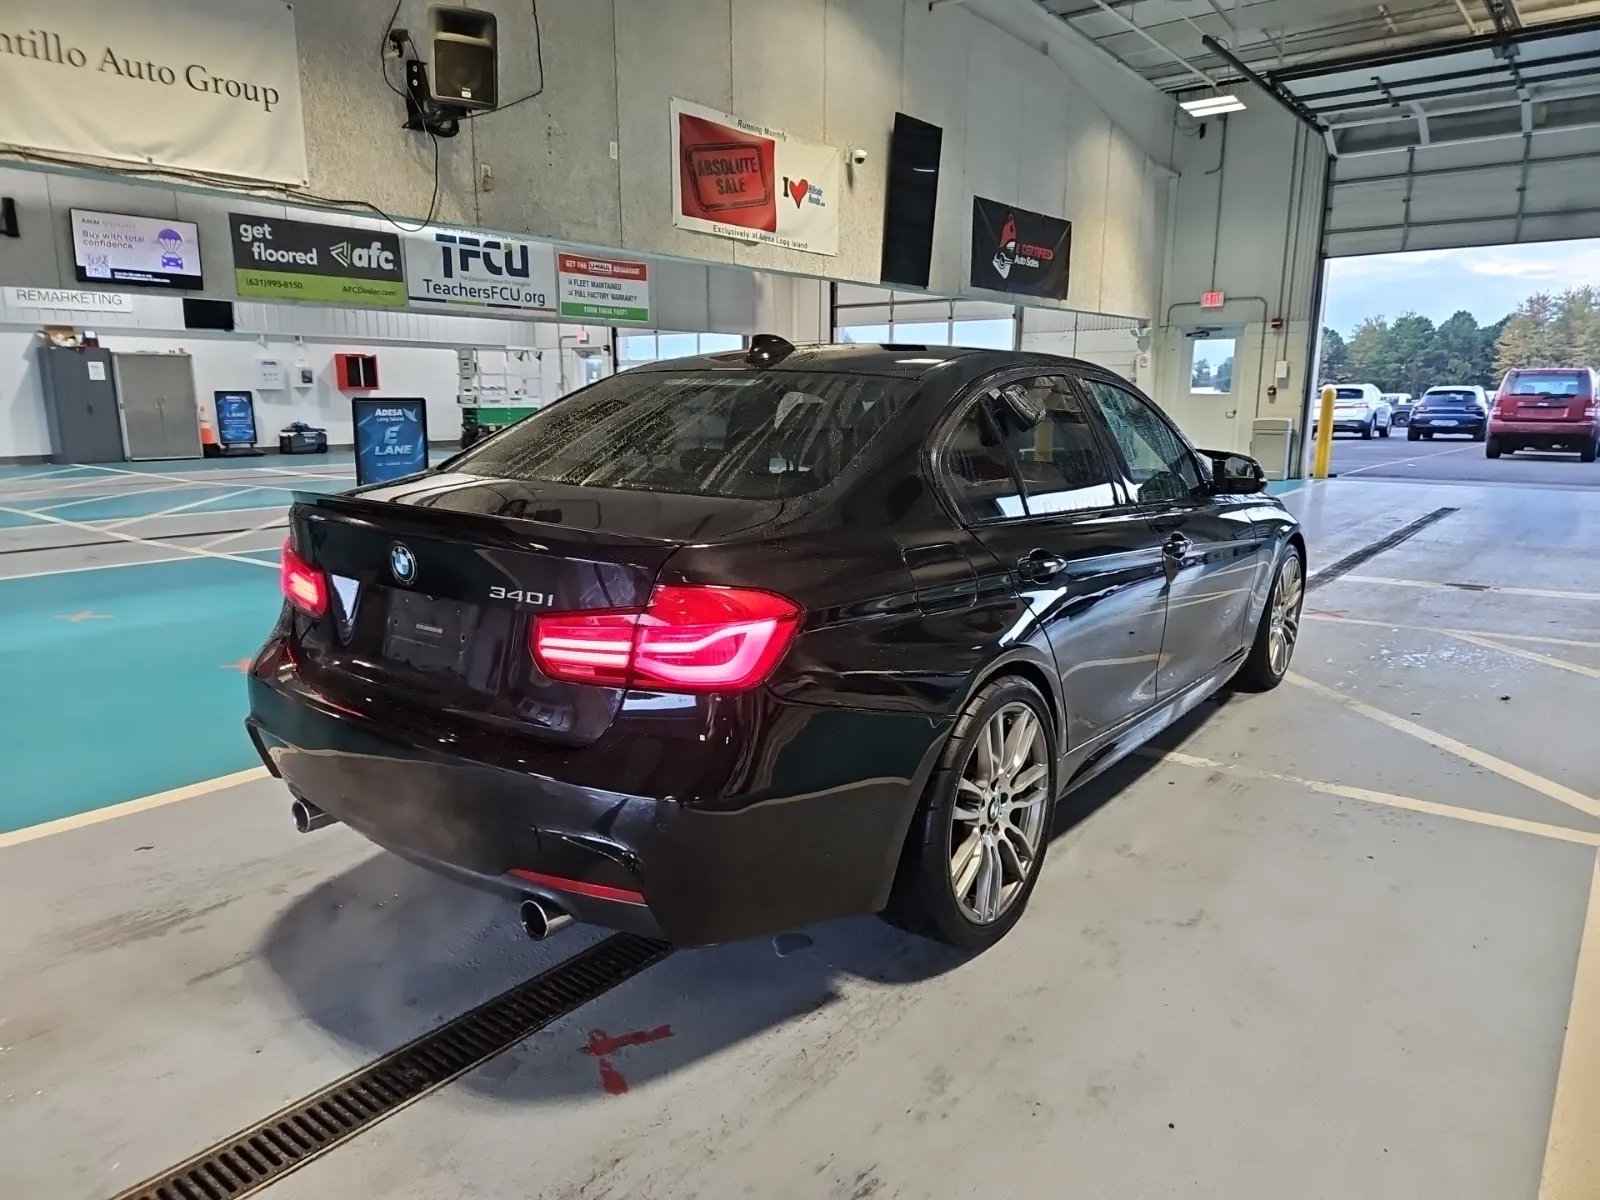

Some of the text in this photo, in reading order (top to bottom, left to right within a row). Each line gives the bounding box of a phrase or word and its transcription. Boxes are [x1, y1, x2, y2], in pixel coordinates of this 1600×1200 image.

[97, 47, 175, 85] Auto
[185, 64, 279, 112] Group
[737, 119, 788, 143] Running Monthly
[696, 157, 758, 176] ABSOLUTE
[716, 176, 746, 195] SALE
[782, 176, 789, 198] I
[82, 229, 145, 244] Buy with total
[239, 223, 272, 242] get
[713, 224, 750, 239] Exclusively
[752, 231, 758, 239] at
[759, 232, 775, 243] Adesa
[791, 238, 808, 250] Island
[252, 242, 318, 266] floored
[352, 241, 394, 270] afc
[435, 233, 530, 278] TFCU
[577, 261, 588, 269] THE
[422, 278, 546, 307] TeachersFCU.org
[573, 279, 622, 290] FLEET MAINTAINED
[16, 289, 122, 306] REMARKETING
[574, 289, 587, 298] FULL
[588, 291, 609, 300] FACTORY
[375, 408, 403, 417] ADESA
[384, 424, 402, 445] E
[374, 444, 413, 456] LANE
